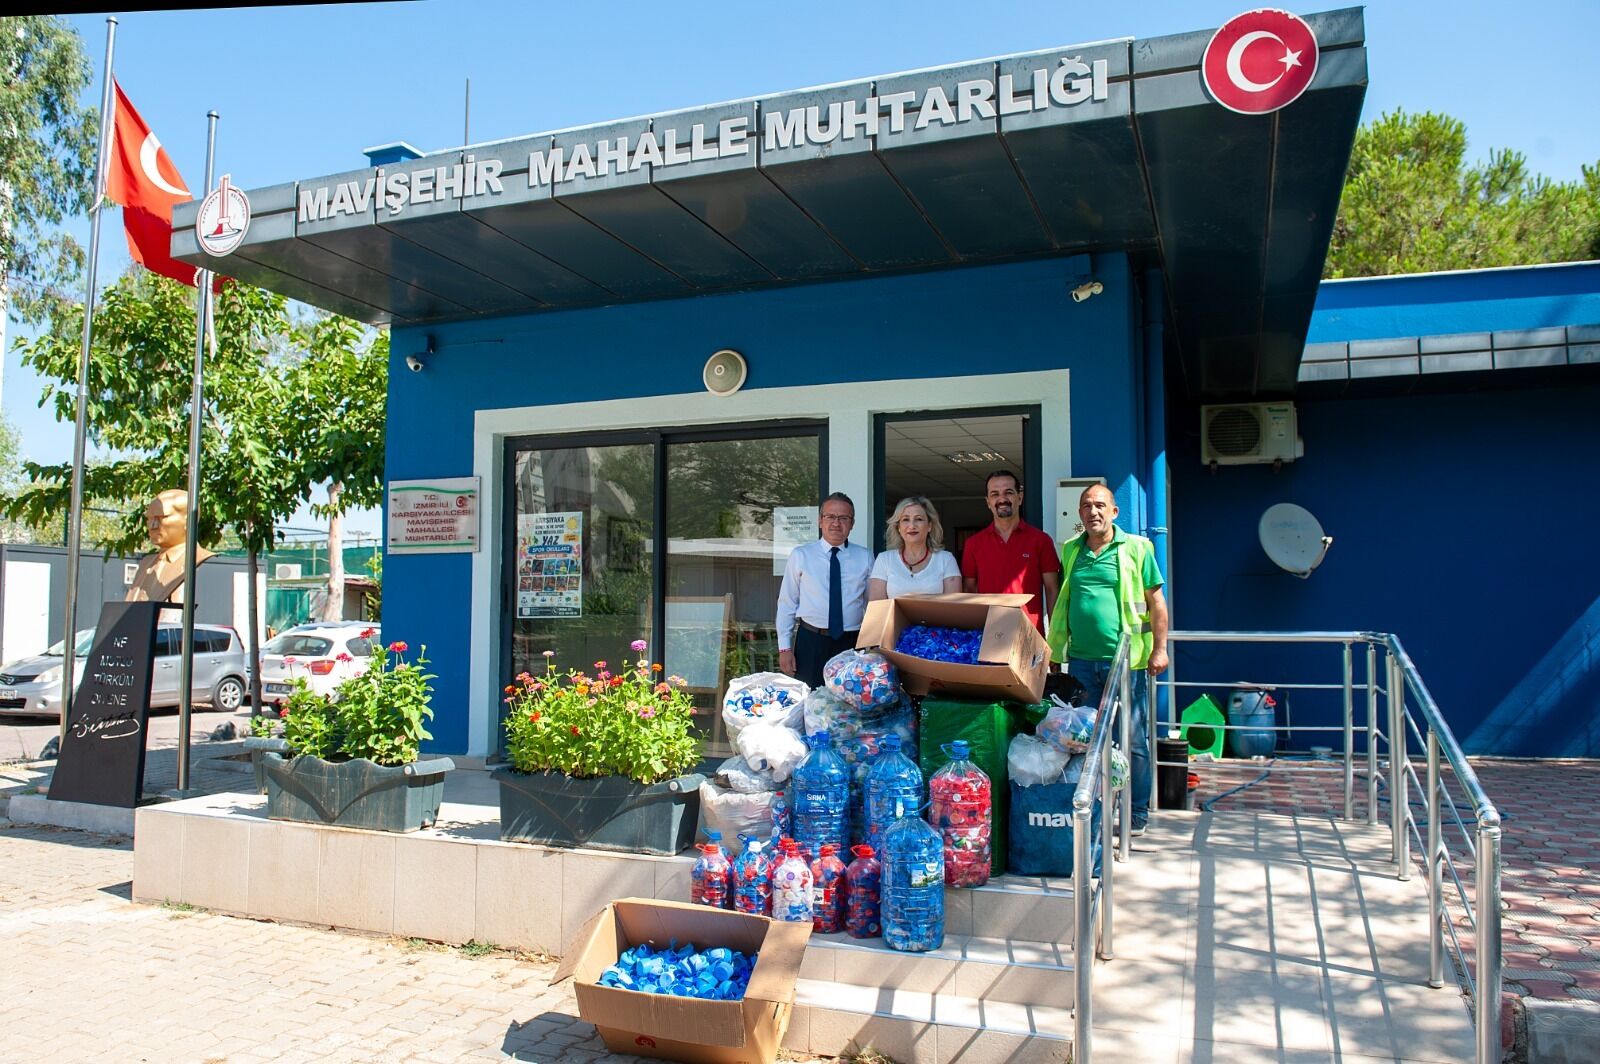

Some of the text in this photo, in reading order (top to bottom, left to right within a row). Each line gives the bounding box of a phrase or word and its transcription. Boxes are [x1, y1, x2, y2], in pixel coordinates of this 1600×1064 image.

[298, 55, 1108, 214] MAVİŞEHİR MAHALLE MUHTARLIĞI
[542, 535, 560, 547] YAZ
[113, 636, 128, 648] NE
[1028, 812, 1074, 828] mav
